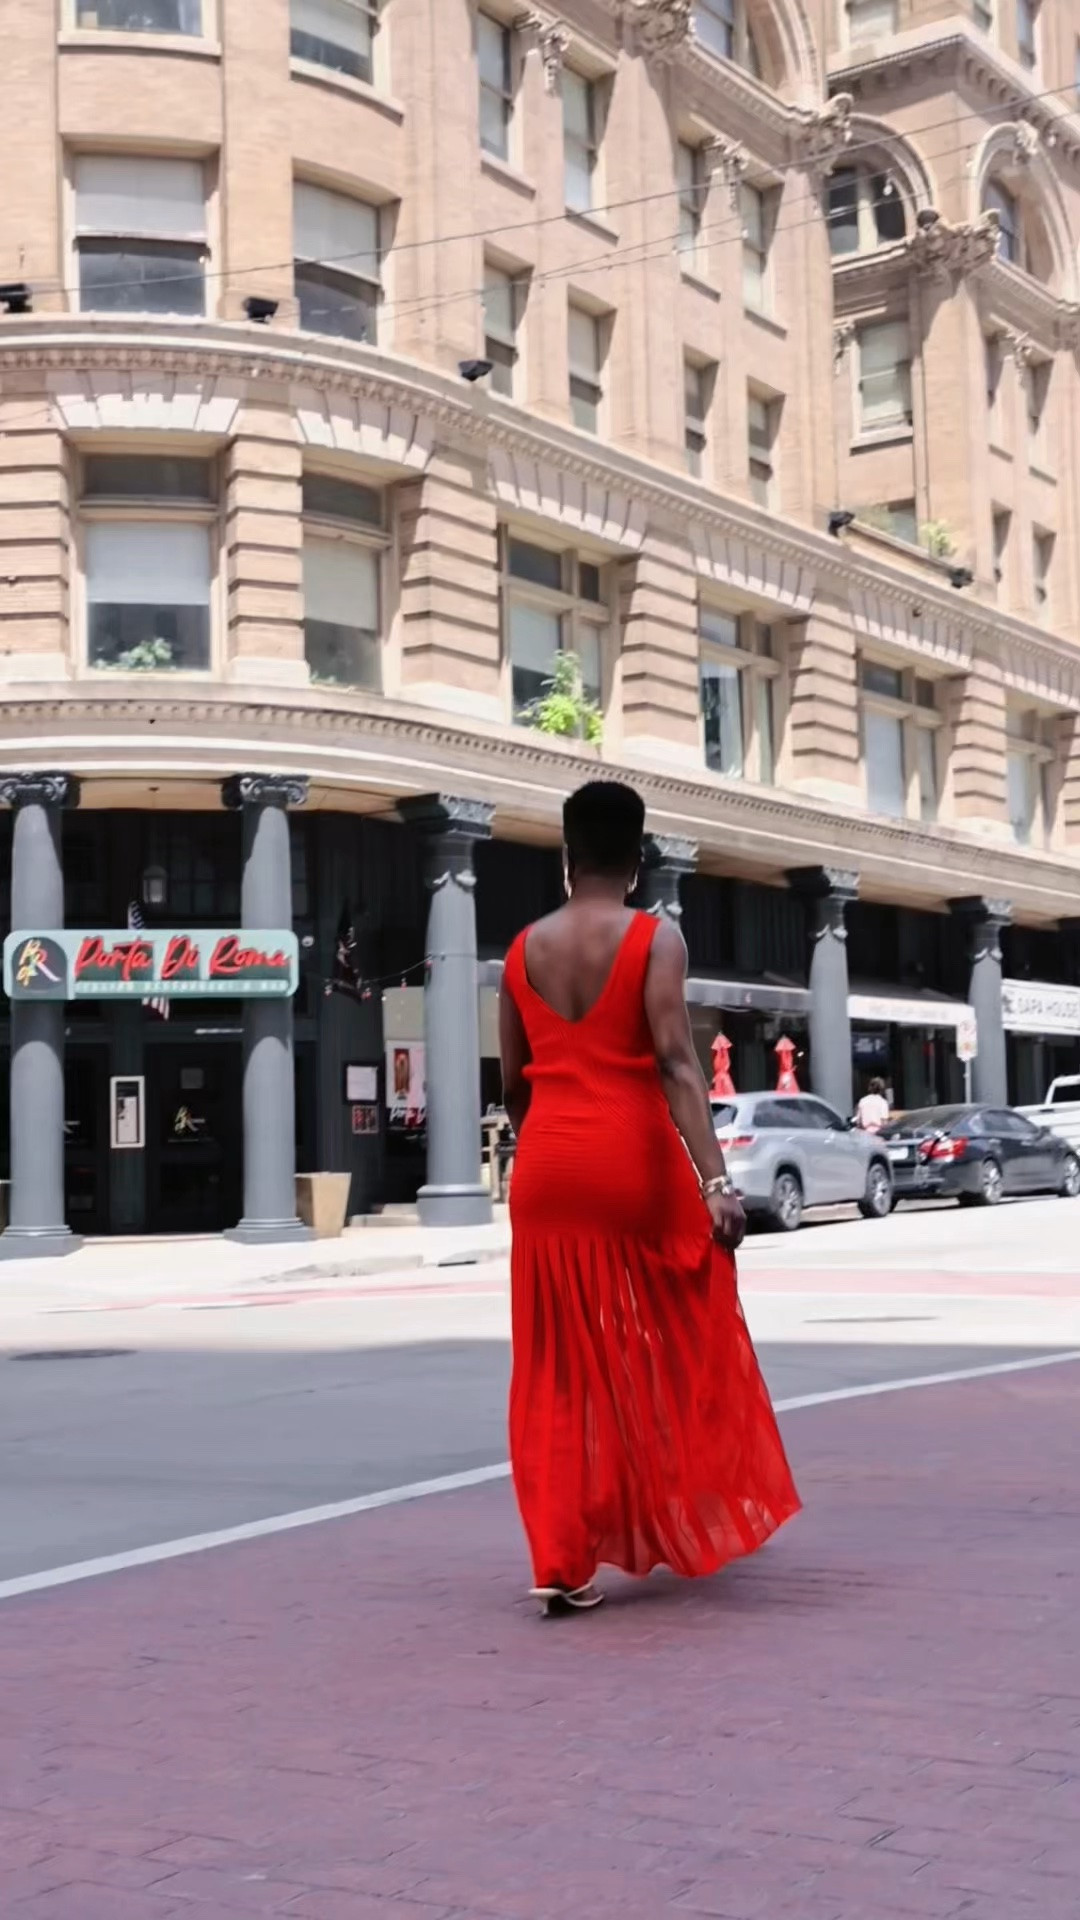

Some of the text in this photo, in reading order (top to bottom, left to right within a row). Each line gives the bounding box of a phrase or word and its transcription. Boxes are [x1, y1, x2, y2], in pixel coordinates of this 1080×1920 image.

[74, 935, 289, 982] Porta Di Roma
